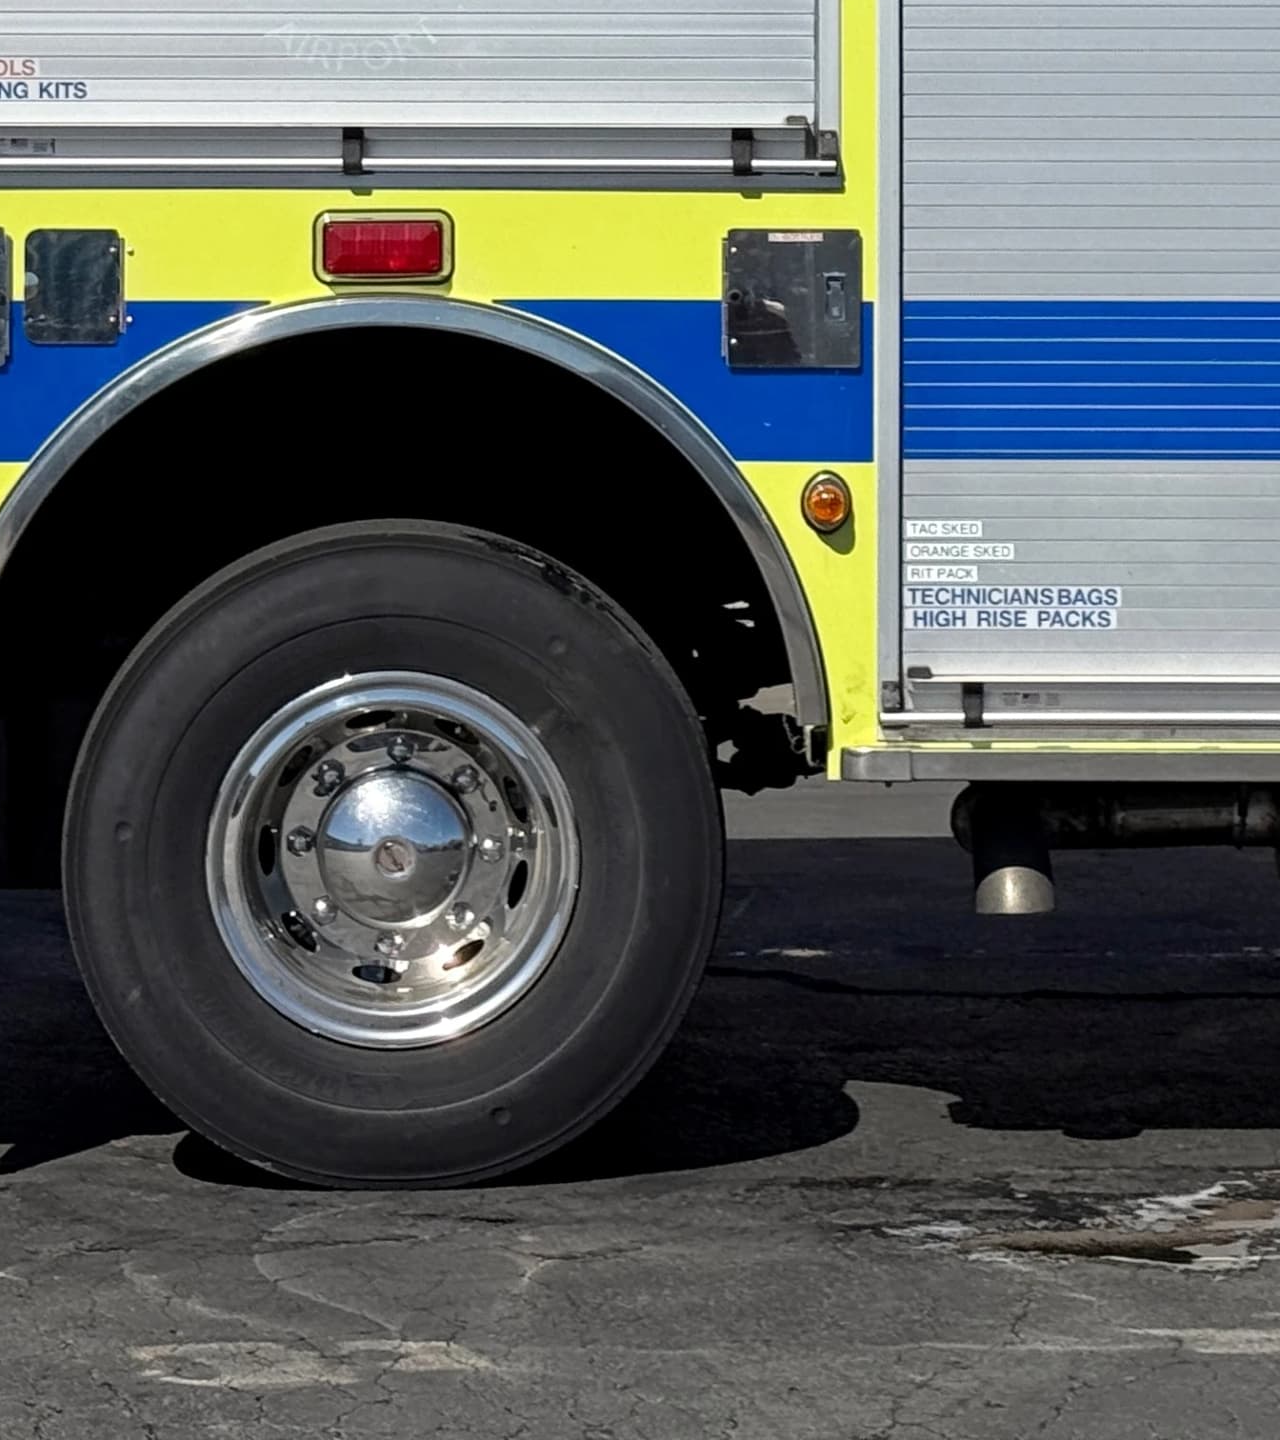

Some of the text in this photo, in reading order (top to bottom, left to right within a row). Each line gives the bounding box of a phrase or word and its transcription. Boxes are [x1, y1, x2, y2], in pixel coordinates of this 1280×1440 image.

[39, 81, 88, 99] KITS
[910, 523, 980, 535] TAC SKED
[910, 545, 1011, 558] ORANGE SKED
[910, 567, 975, 580] RIT PACK
[907, 587, 1119, 606] TECHNICIANS BAGS
[913, 610, 1112, 627] HIGH RISE PACKS
